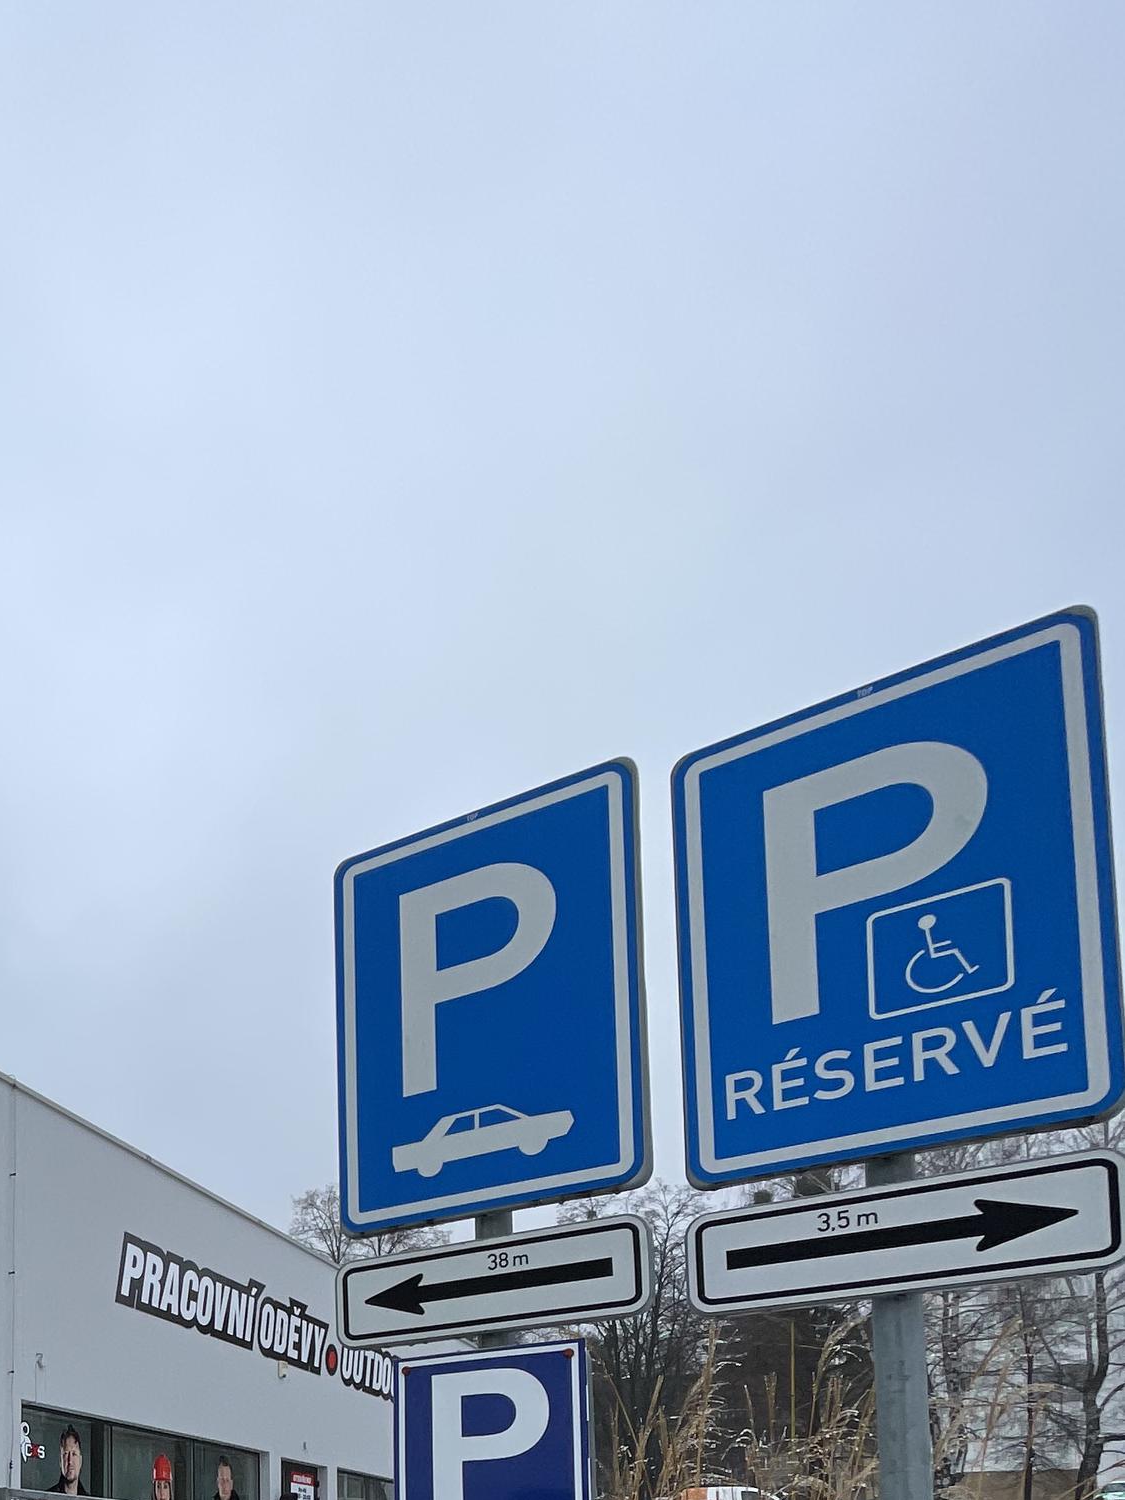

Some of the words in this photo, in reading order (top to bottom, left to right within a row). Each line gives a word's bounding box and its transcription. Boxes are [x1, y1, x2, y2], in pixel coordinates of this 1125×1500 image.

[763, 741, 988, 1026] P
[399, 862, 557, 1098] P
[725, 988, 1069, 1120] RÉSERVÉ
[487, 1252, 509, 1270] 38
[512, 1254, 529, 1266] m
[817, 1210, 850, 1232] 3,5
[857, 1212, 878, 1227] m
[120, 1240, 256, 1342] PRACOVNÍ
[259, 1303, 325, 1368] ODĚVY
[341, 1347, 394, 1395] OUTDO
